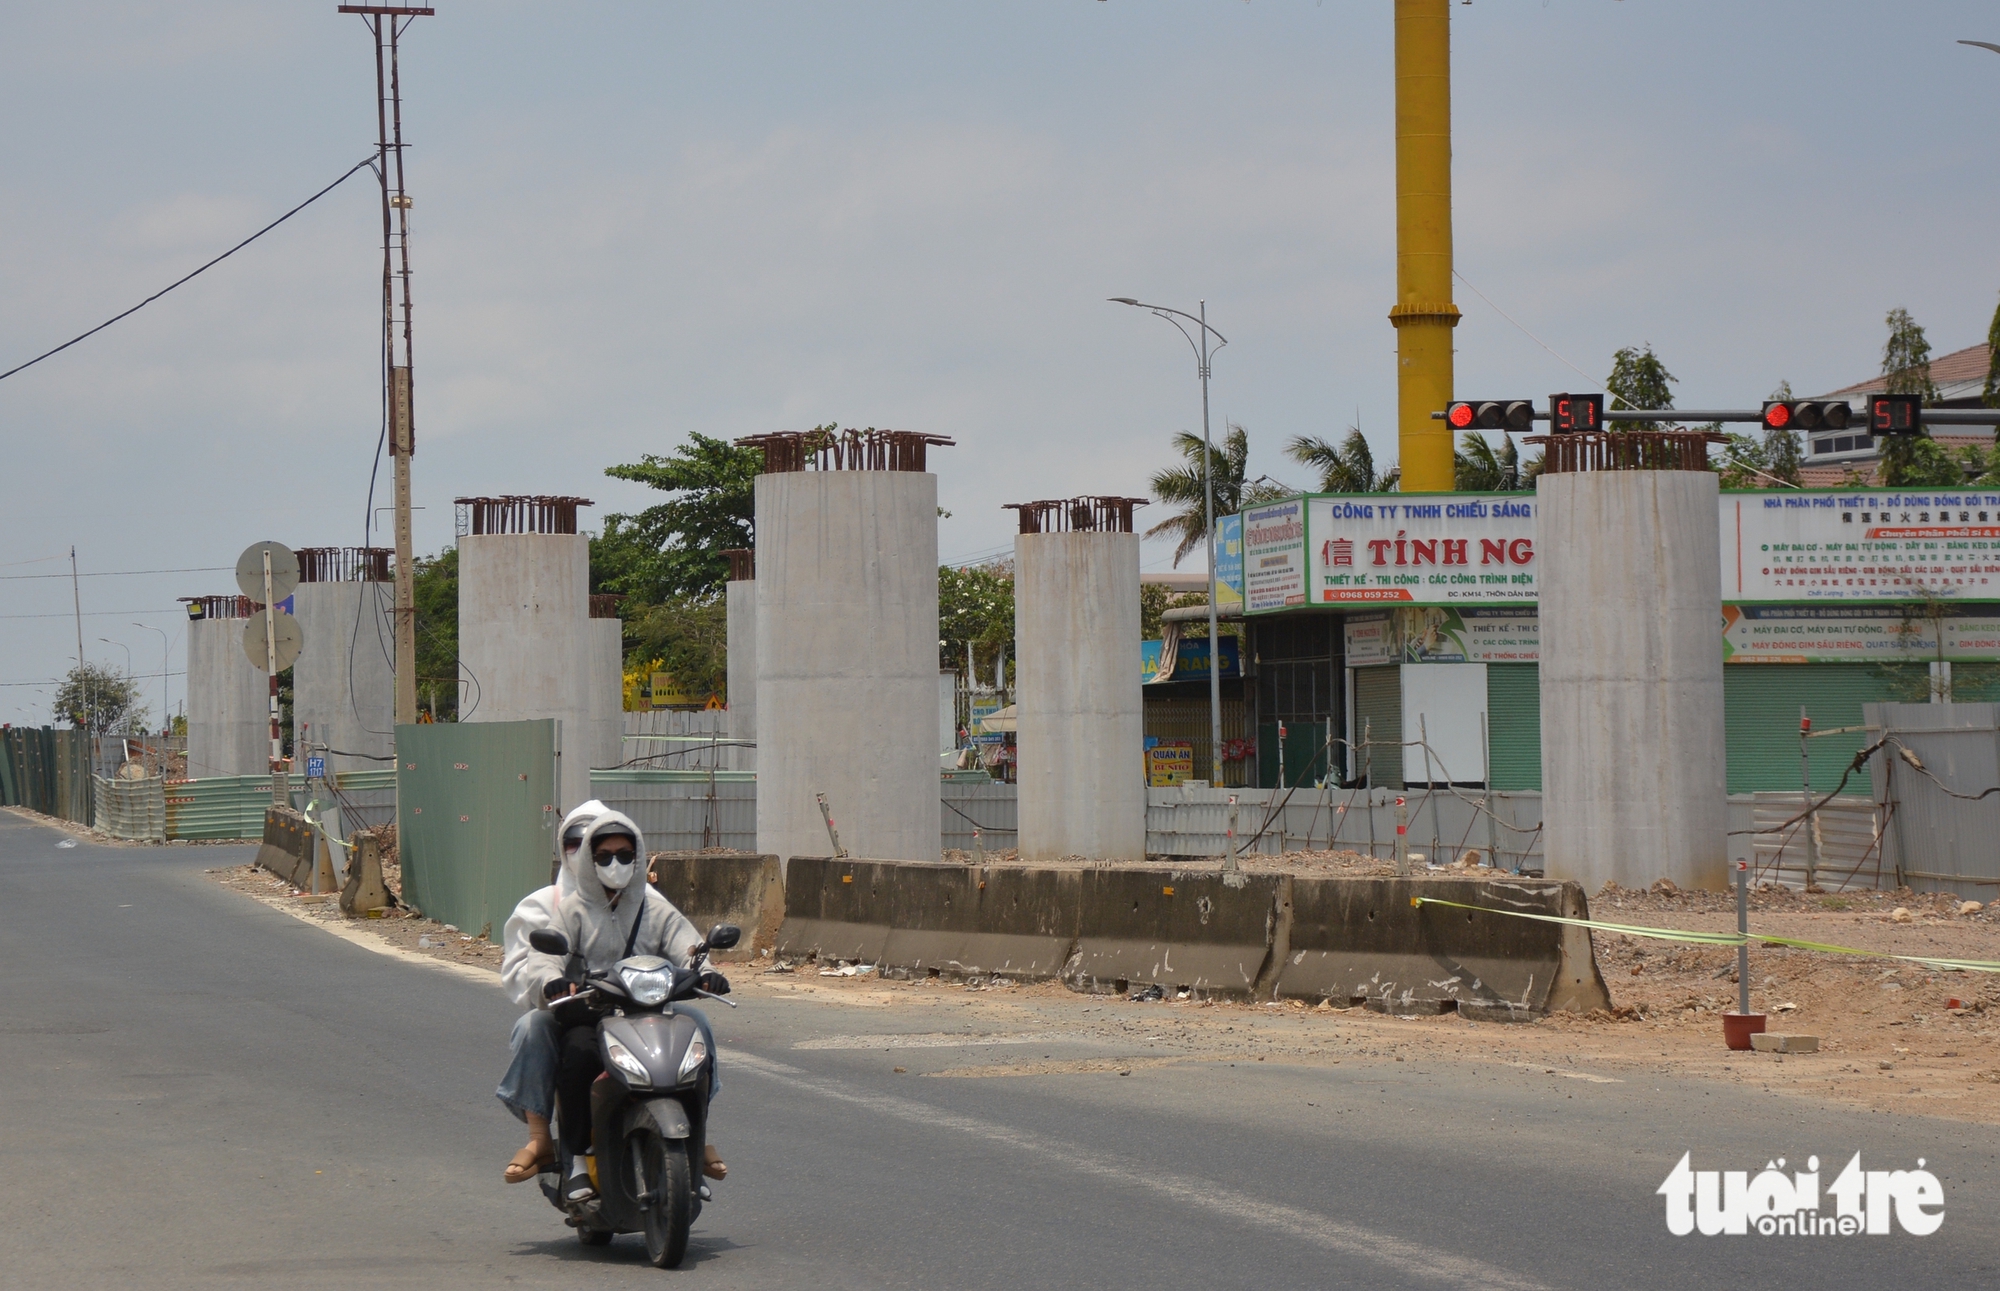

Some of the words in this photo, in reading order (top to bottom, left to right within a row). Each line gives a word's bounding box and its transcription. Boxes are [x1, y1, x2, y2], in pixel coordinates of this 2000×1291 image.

[1558, 400, 1595, 428] 51
[1875, 400, 1911, 428] 51
[1764, 496, 1782, 508] NHÀ
[1785, 496, 1810, 508] PHÂN
[1813, 495, 1836, 508] PHỐI
[1838, 495, 1865, 508] THIẾT
[1869, 498, 1878, 509] BỊ
[1905, 494, 1930, 507] DÙNG
[1935, 494, 1961, 507] ĐÓNG
[1965, 494, 1981, 506] GÓI
[1333, 502, 1373, 519] CÔNG
[1379, 505, 1397, 519] TY
[1403, 505, 1441, 519] TNHH
[1446, 500, 1487, 518] CHIẾU
[1492, 501, 1531, 518] SÁNG
[1321, 537, 1354, 567] 信
[1366, 529, 1469, 567] TÍNH
[1479, 538, 1536, 567] NG
[1773, 543, 1790, 551] MÁY
[1826, 543, 1843, 551] MÁY
[1845, 543, 1858, 551] ĐAI
[1874, 543, 1897, 552] ĐỘNG
[1972, 541, 1989, 549] KEO
[1324, 573, 1350, 585] THIẾT
[1354, 573, 1368, 585] KẾ
[1376, 575, 1391, 585] THI
[1394, 573, 1419, 585] CÔNG
[1428, 573, 1447, 584] CÁC
[1451, 573, 1476, 584] CÔNG
[1479, 573, 1507, 585] TRÌNH
[1511, 572, 1533, 586] ĐIỆN
[1340, 591, 1362, 599] 0968
[1364, 591, 1380, 599] 059
[1473, 623, 1495, 632] THIẾT
[1499, 622, 1510, 632] KẾ
[1754, 625, 1772, 634] MÁY
[1774, 626, 1789, 634] ĐAI
[1807, 624, 1825, 634] MÁY
[1858, 625, 1883, 634] ĐỘNG
[1752, 640, 1770, 649] MÁY
[1772, 640, 1796, 649] ĐÓNG
[1798, 641, 1815, 649] GIM
[309, 758, 323, 768] H7
